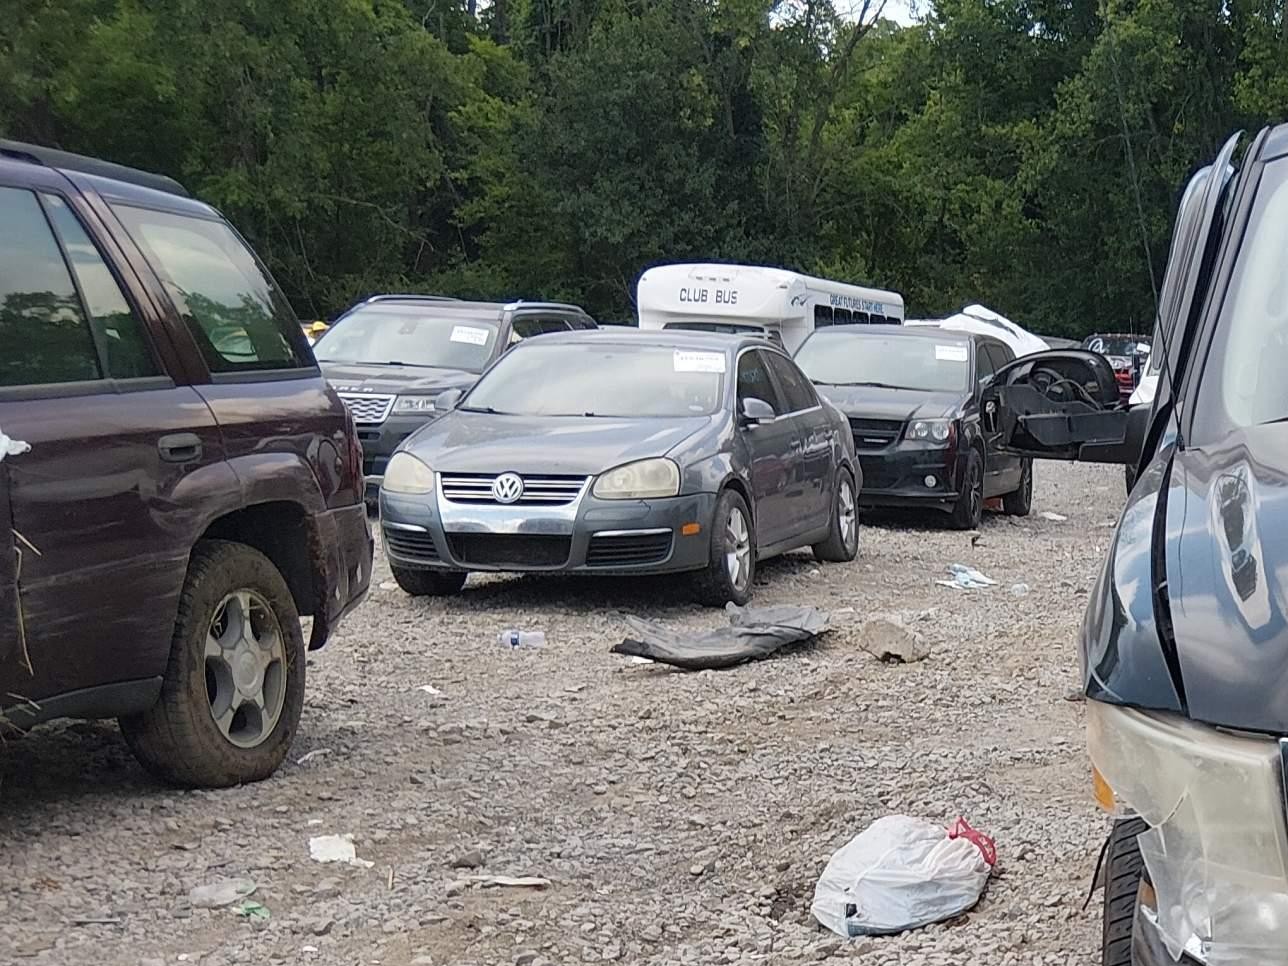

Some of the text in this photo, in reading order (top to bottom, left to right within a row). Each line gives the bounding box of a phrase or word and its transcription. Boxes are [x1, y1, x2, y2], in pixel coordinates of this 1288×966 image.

[679, 288, 738, 304] CLUB BUS
[829, 295, 844, 307] GREAT
